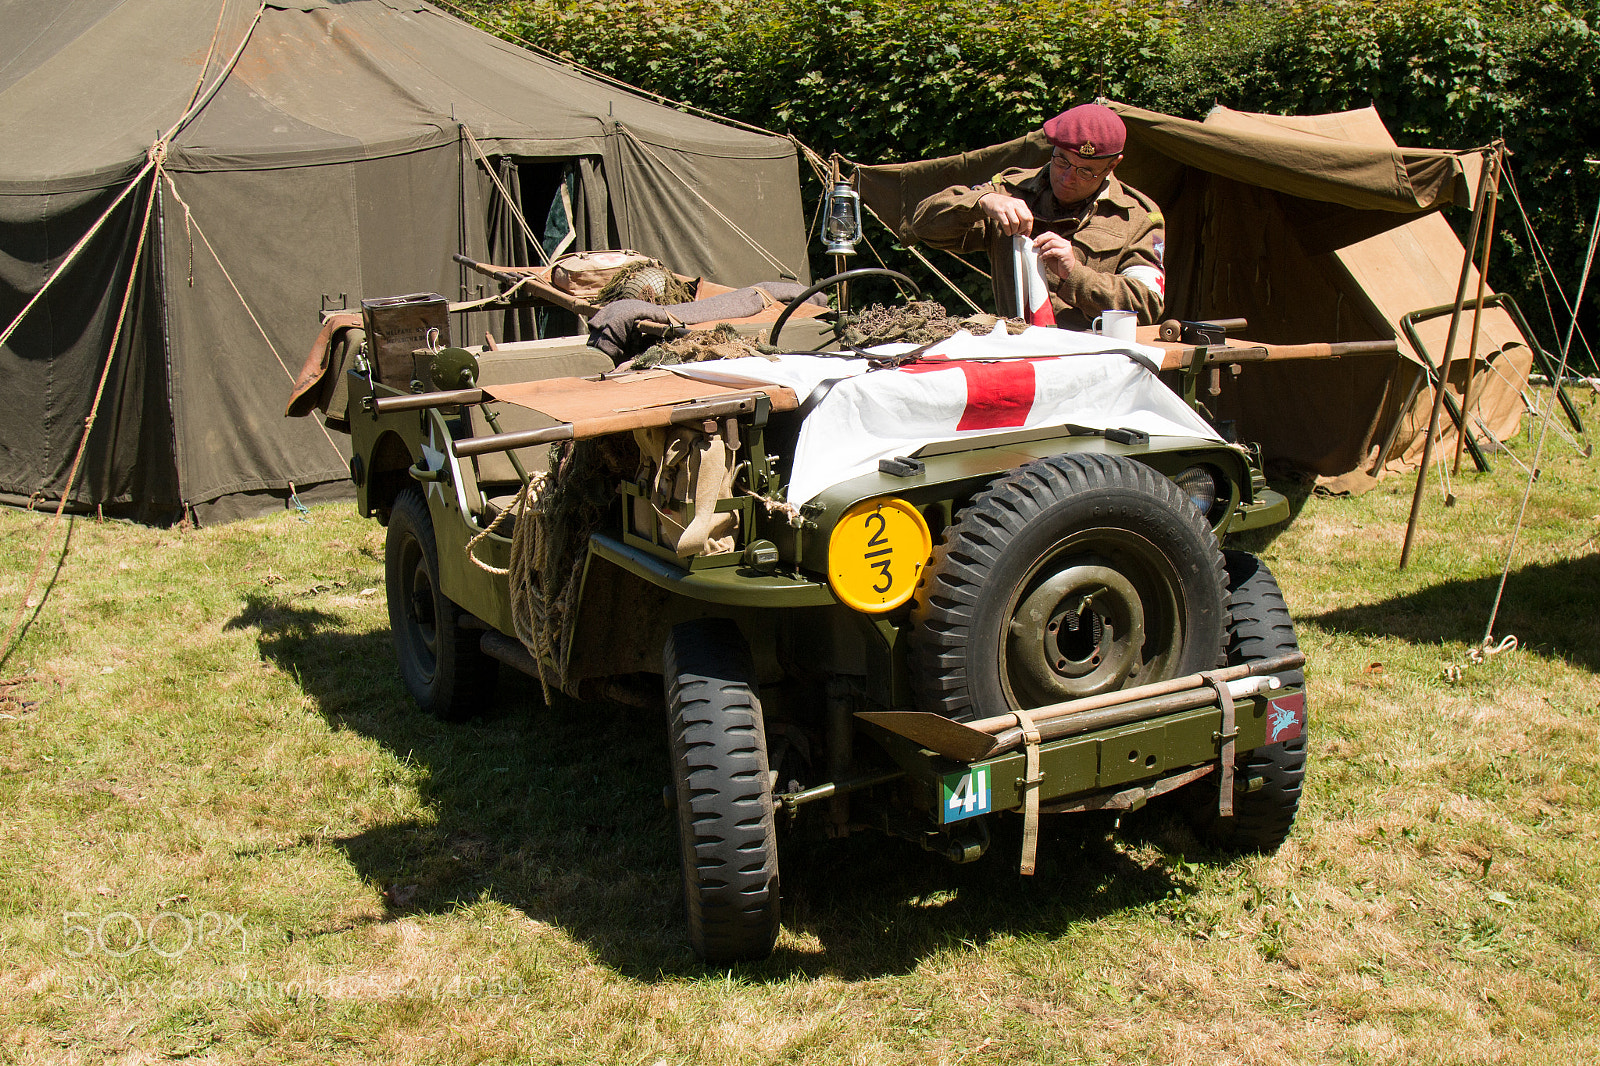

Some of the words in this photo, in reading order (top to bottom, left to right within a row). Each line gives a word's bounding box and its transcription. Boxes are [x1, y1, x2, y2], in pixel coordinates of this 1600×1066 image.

[865, 513, 888, 547] 2
[870, 559, 893, 593] 3
[949, 770, 986, 812] 41
